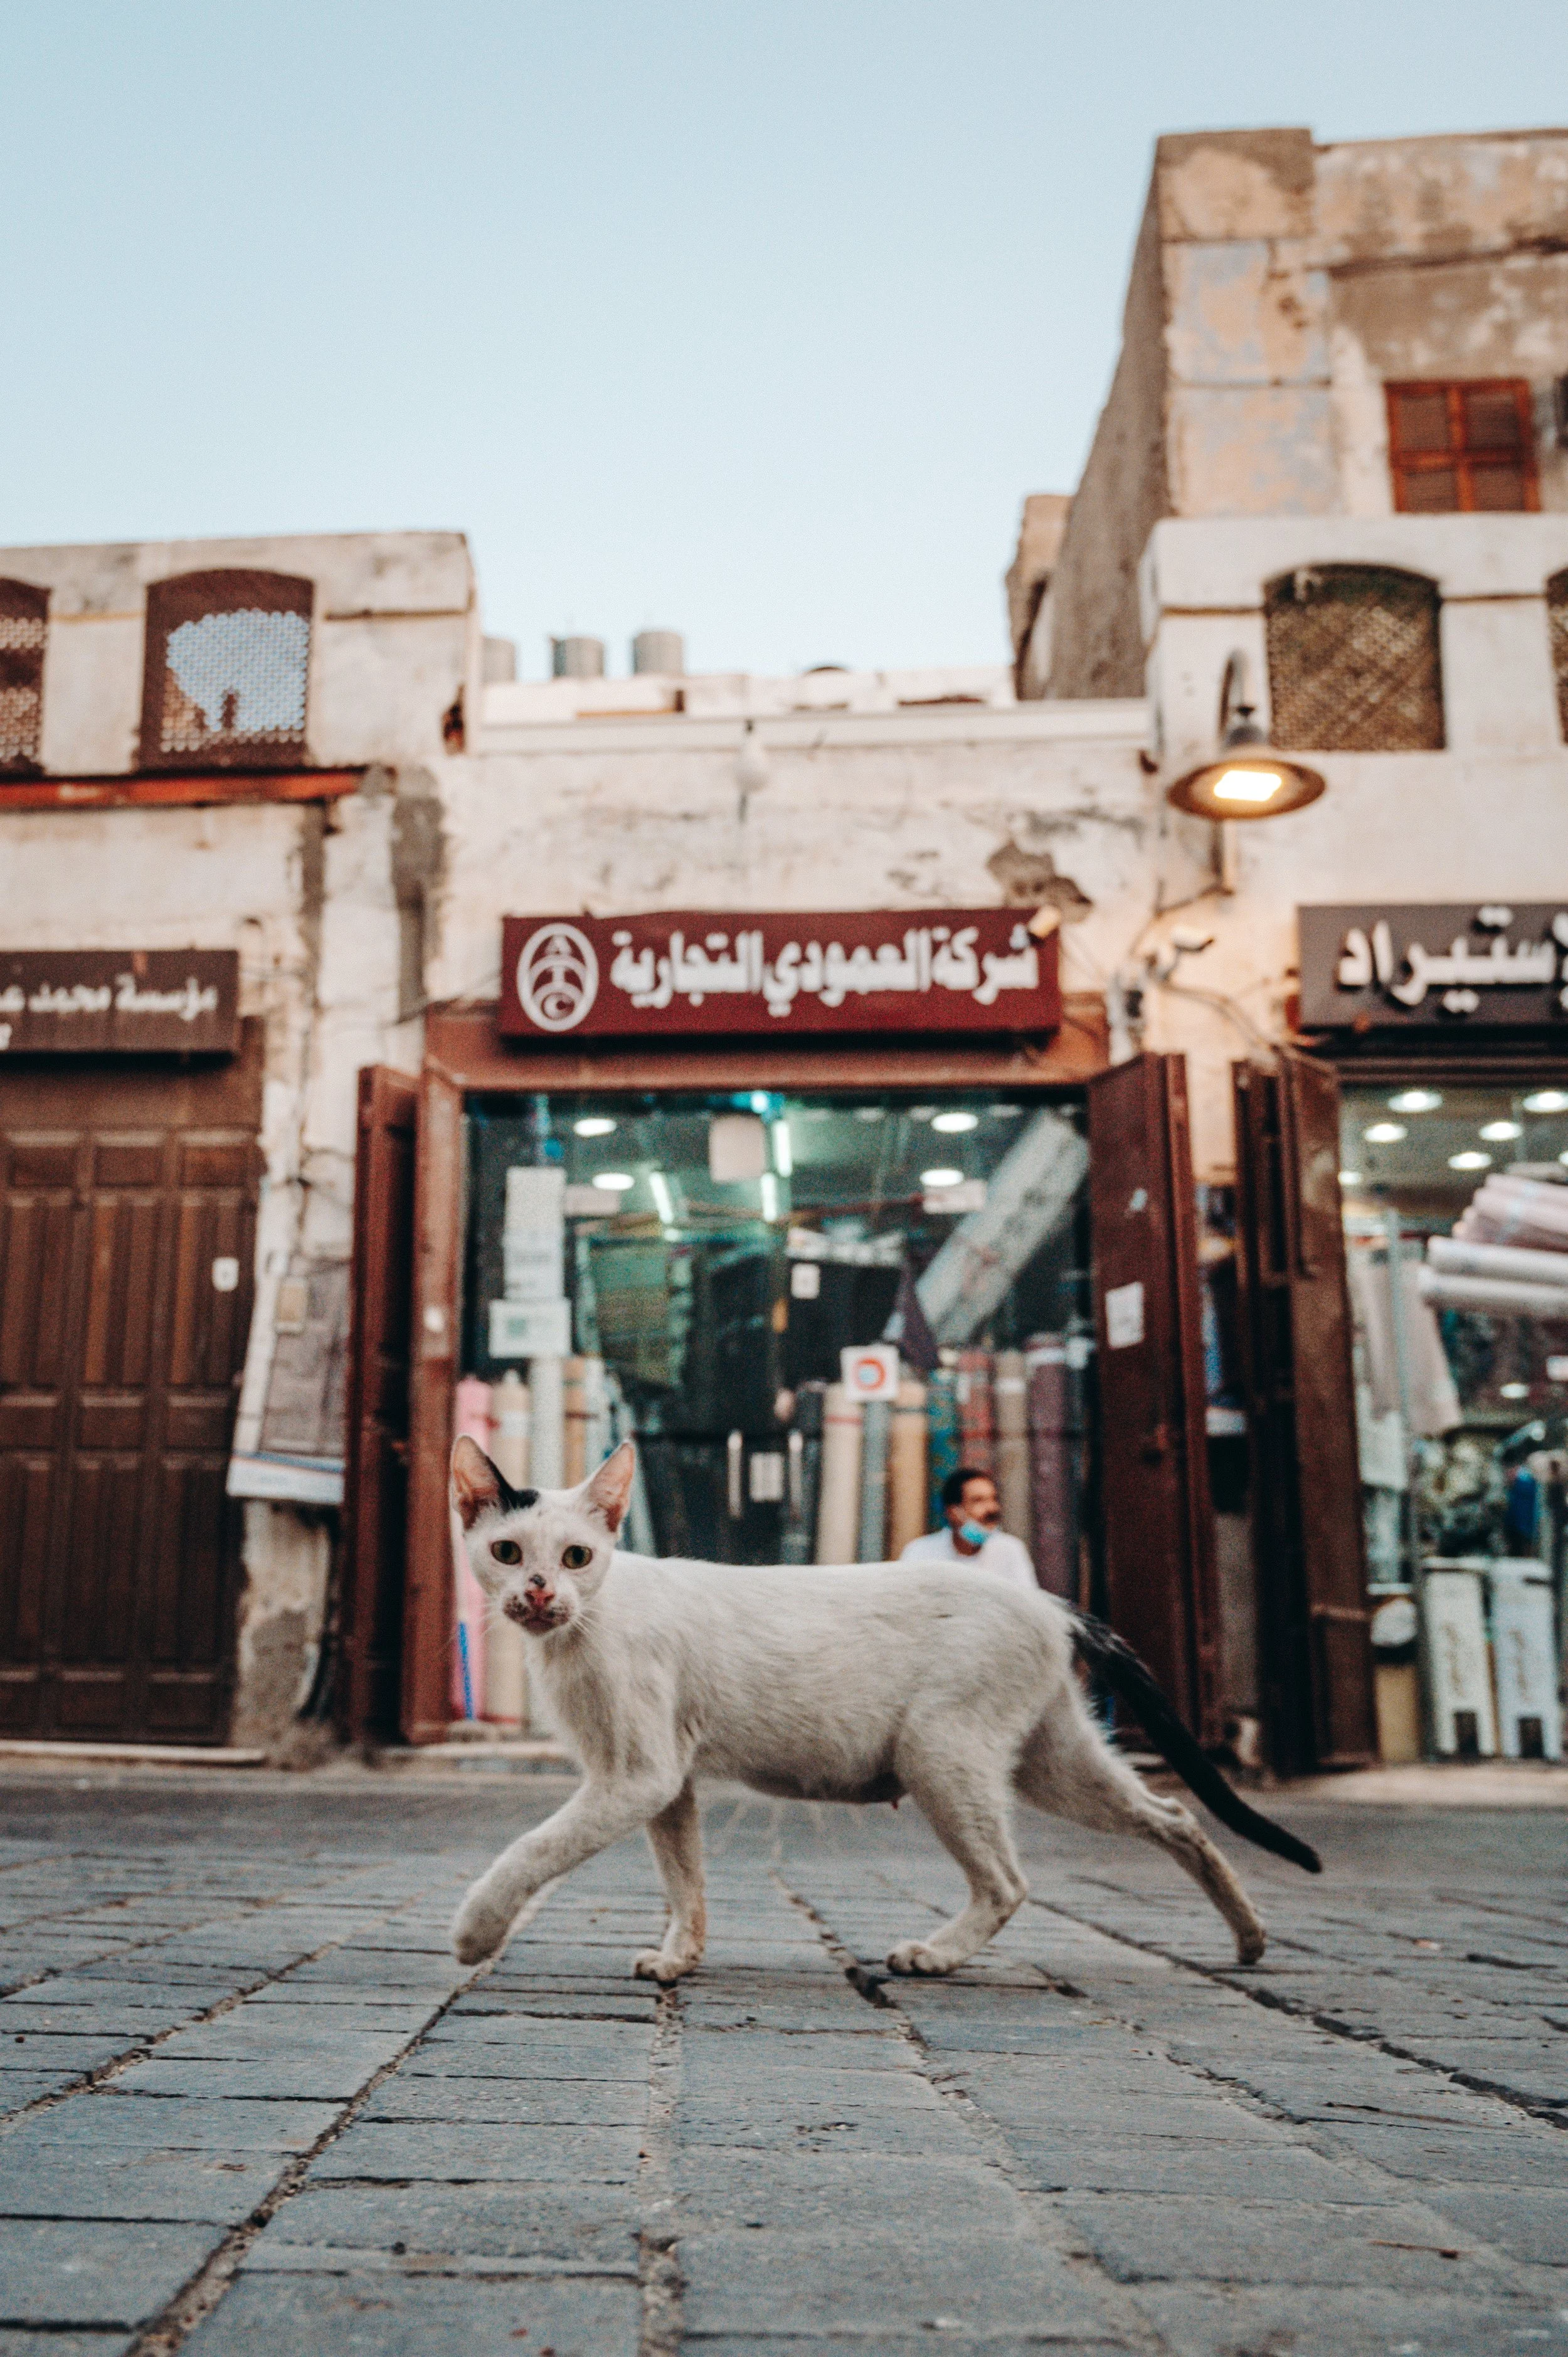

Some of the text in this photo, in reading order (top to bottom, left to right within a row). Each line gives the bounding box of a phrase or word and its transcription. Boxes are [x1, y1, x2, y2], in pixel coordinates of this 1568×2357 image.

[115, 973, 219, 1022] مؤسسة
[609, 923, 1040, 1018] شركة العمودي التجارية
